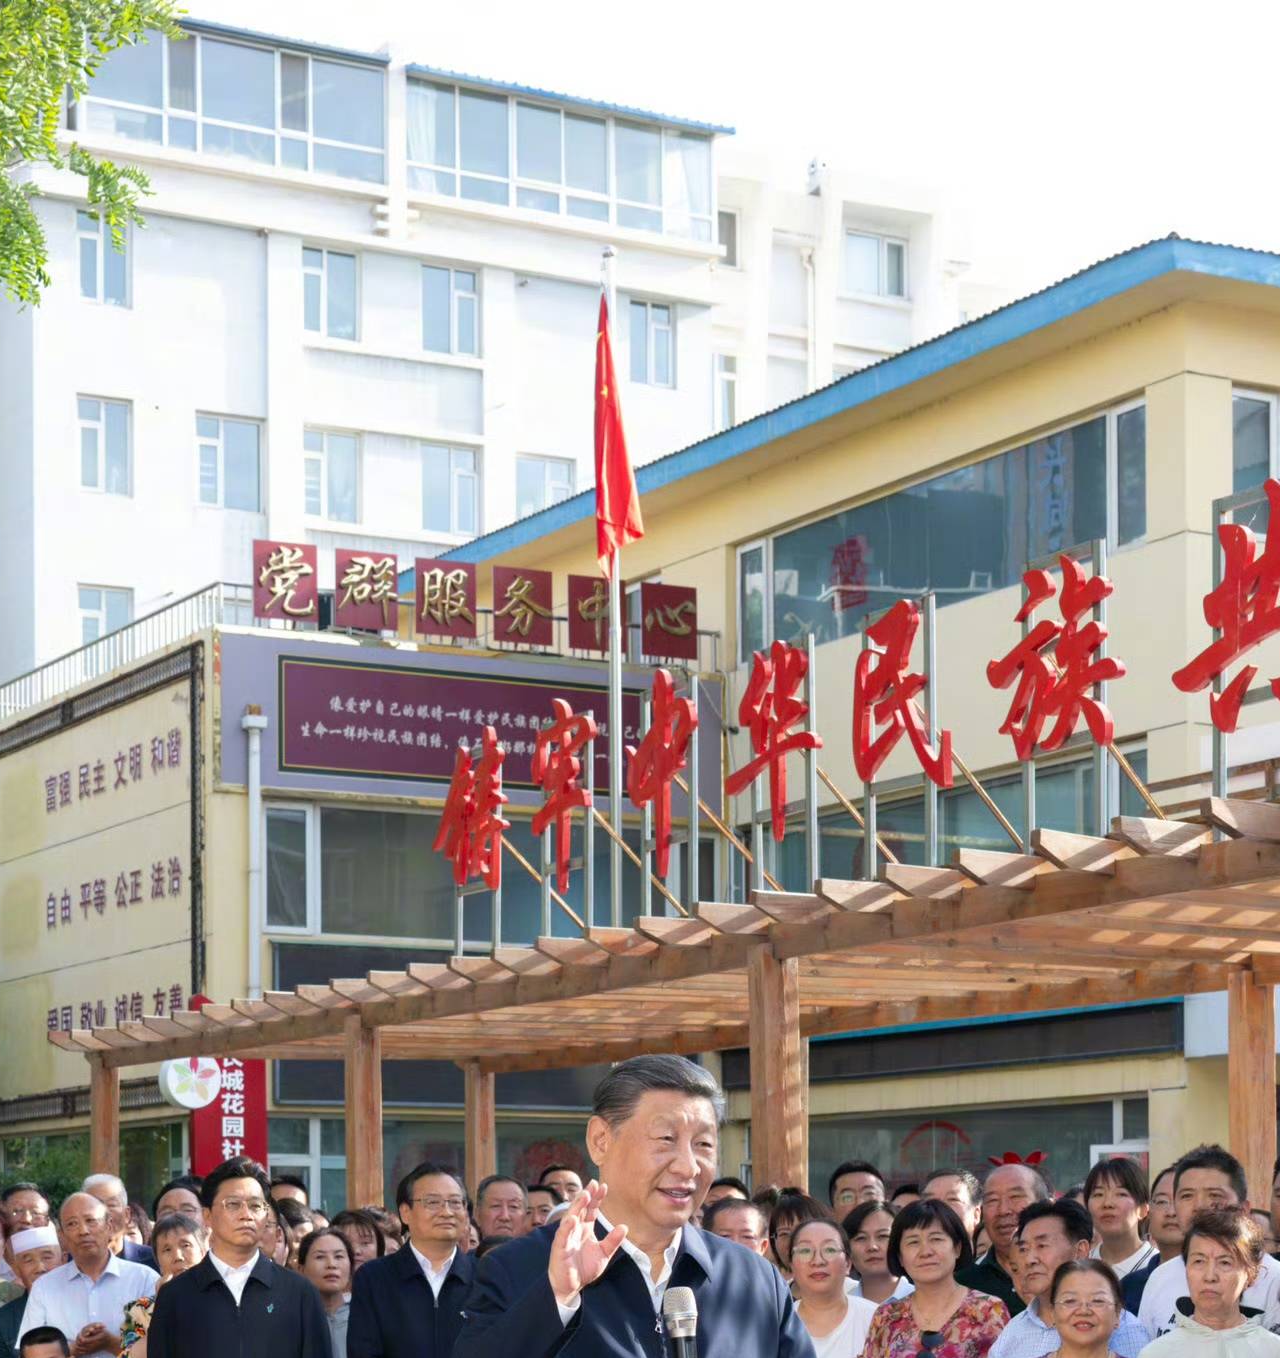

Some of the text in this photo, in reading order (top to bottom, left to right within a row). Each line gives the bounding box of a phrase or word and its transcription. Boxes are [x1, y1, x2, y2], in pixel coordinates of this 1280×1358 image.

[259, 546, 697, 647] 党群服务中心
[45, 727, 181, 813] 富强 民主 文明 和谐
[46, 856, 182, 930] 自由 平等 公正 法治
